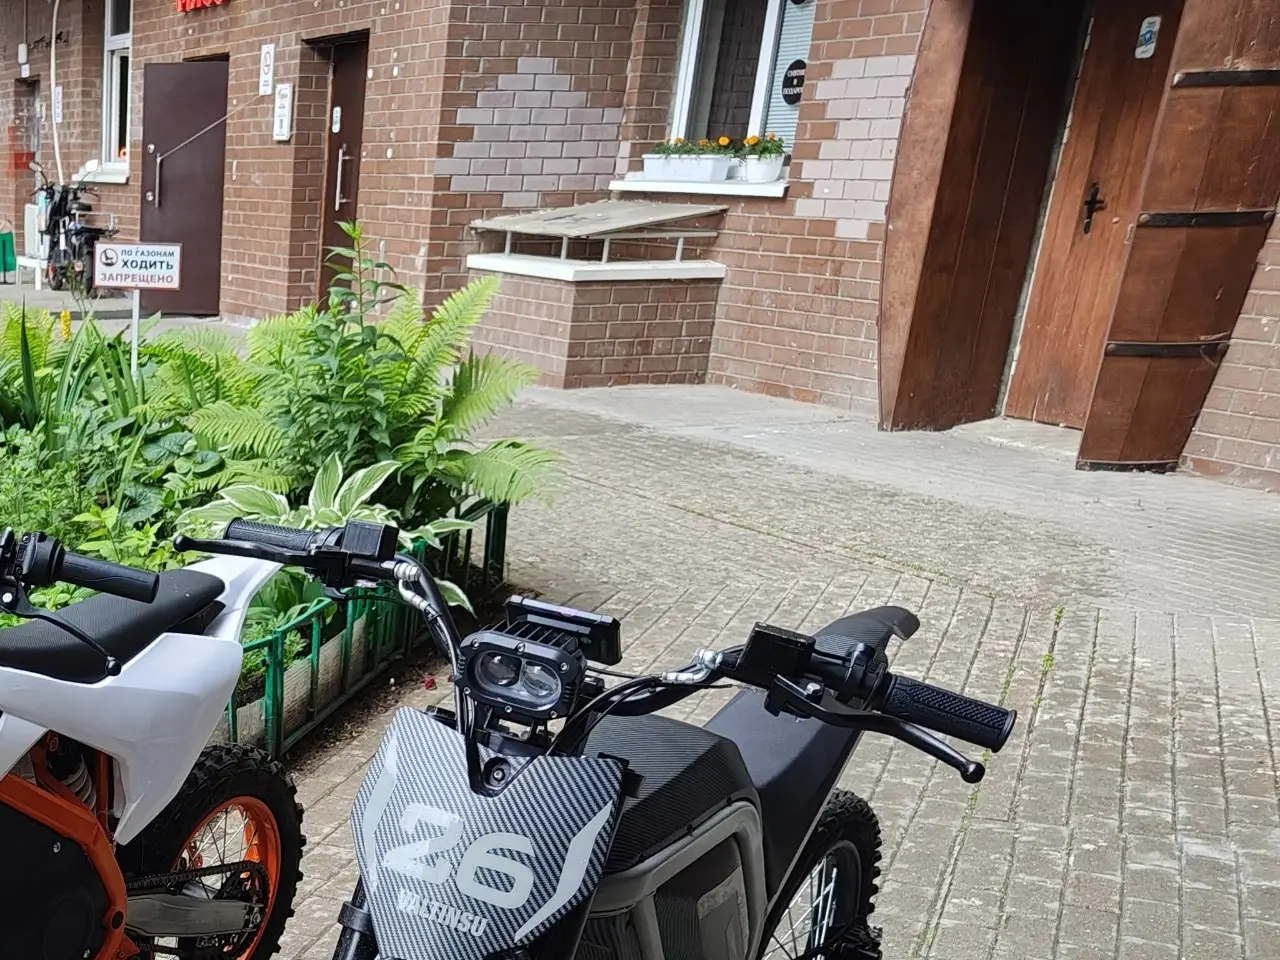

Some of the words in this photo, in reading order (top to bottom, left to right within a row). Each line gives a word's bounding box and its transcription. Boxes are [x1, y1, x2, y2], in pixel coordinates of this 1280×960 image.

[120, 249, 133, 257] ПО
[135, 250, 175, 258] ГАЗОНАМ
[120, 259, 174, 270] ХОДИТЬ
[100, 273, 174, 284] ЗАПРЕЩЕНО
[384, 803, 536, 909] 26
